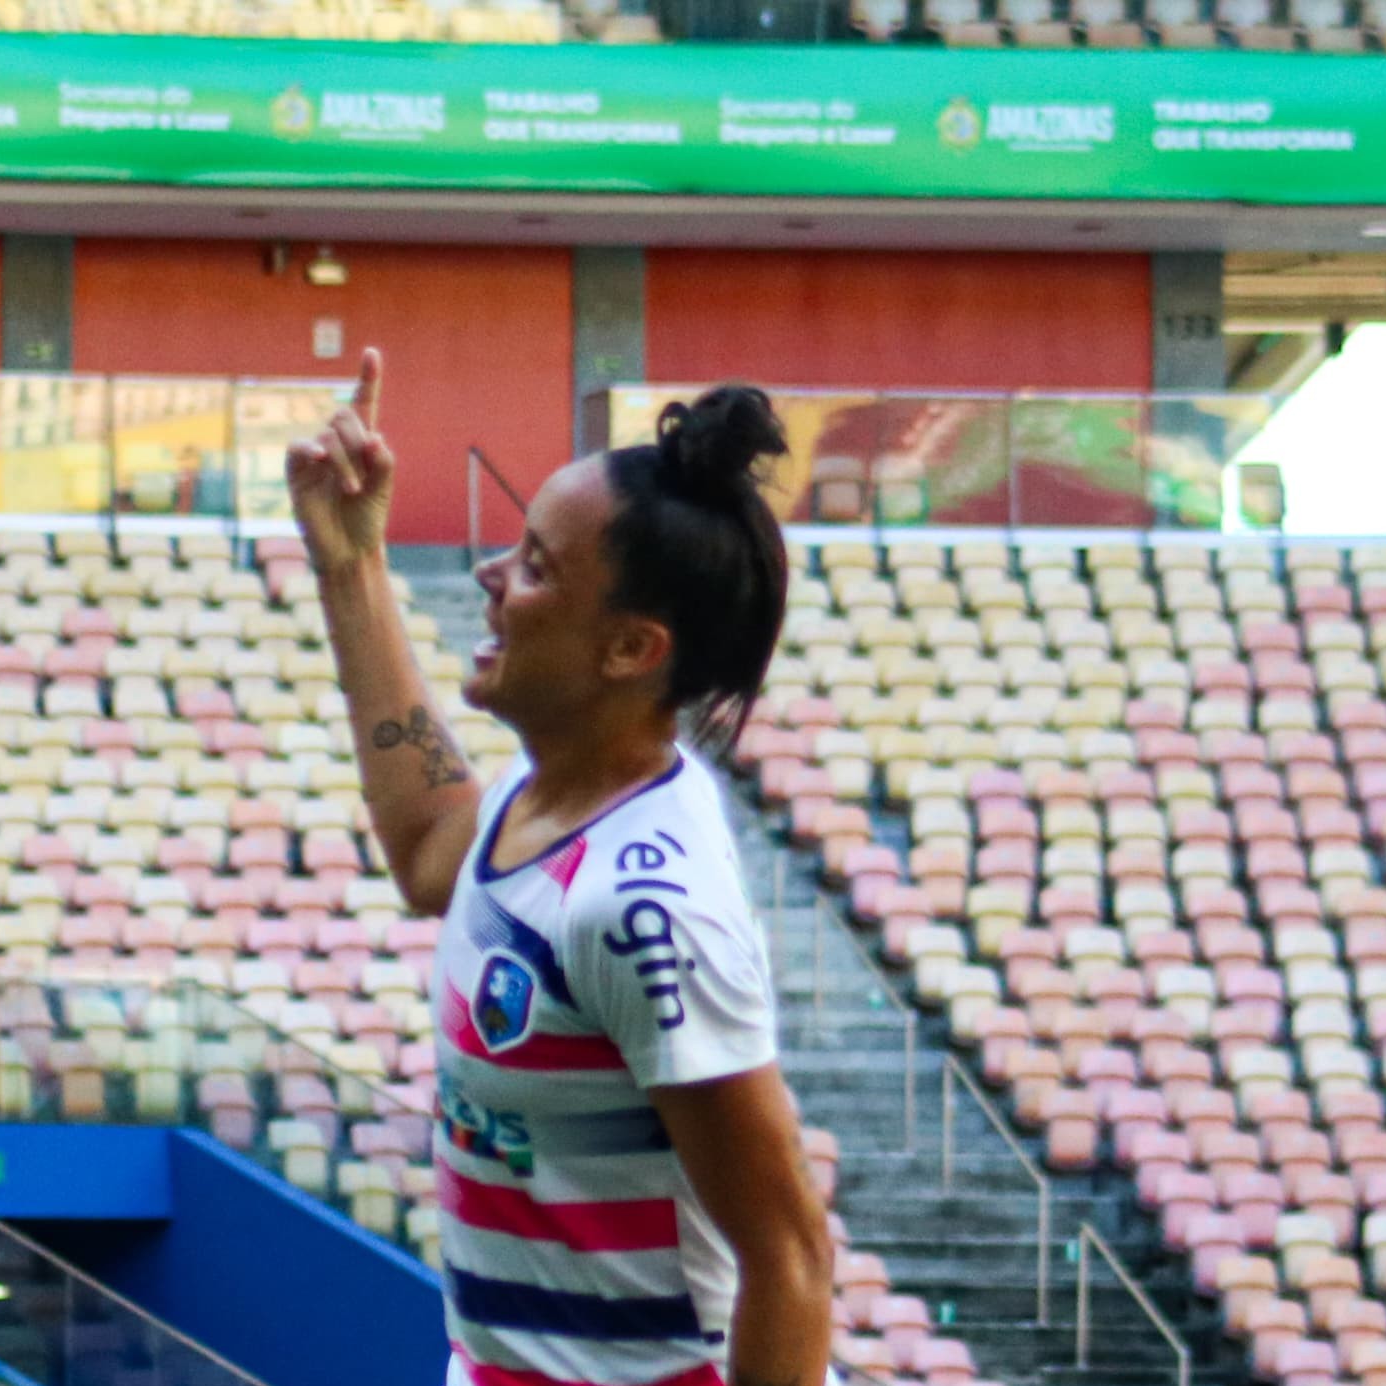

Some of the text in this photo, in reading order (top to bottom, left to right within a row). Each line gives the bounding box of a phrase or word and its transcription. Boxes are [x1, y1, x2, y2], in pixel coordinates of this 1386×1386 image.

[320, 92, 444, 131] AMAZONAS
[485, 90, 599, 114] TRABALHO
[1153, 101, 1271, 123] TRABALHO
[484, 119, 680, 143] QUE TRANSFORMA
[988, 105, 1113, 142] AMAZONAS
[1153, 129, 1354, 150] QUE TRANSFORMA
